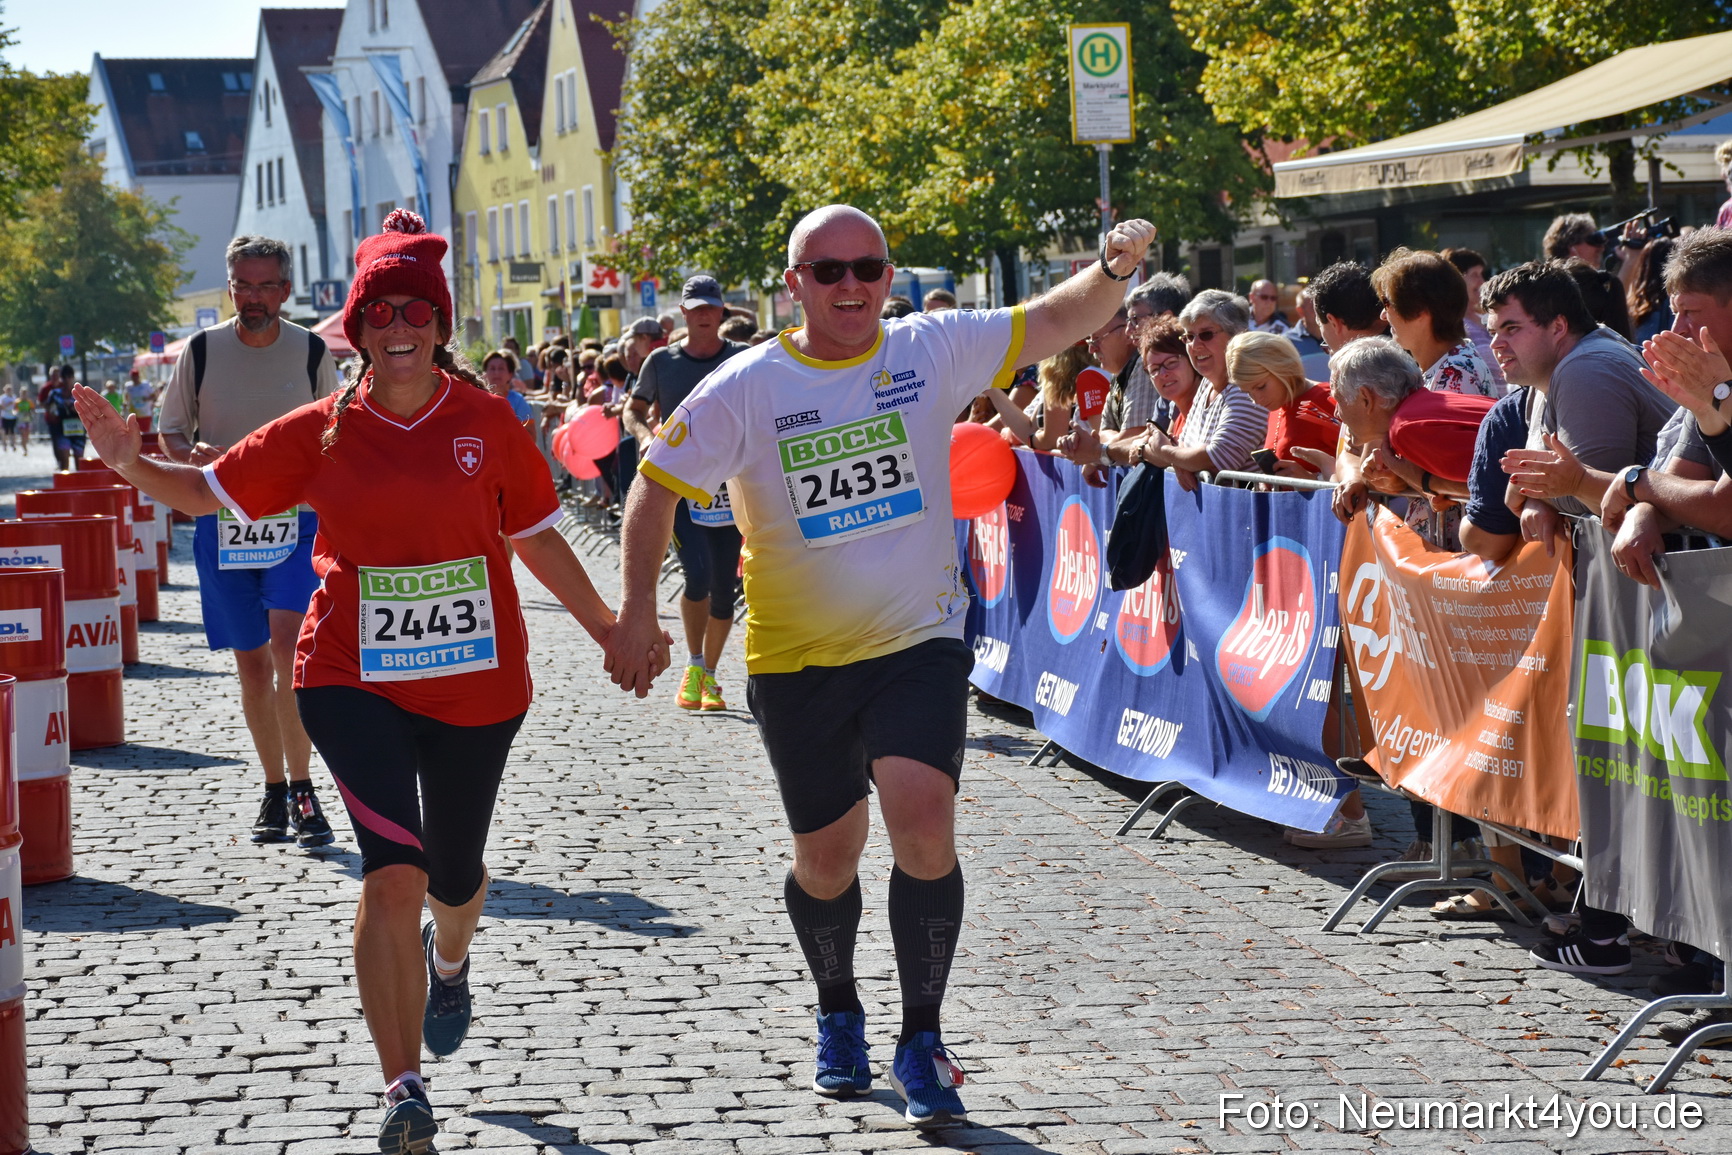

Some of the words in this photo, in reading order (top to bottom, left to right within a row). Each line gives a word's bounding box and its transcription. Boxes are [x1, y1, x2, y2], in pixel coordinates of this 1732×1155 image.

[1083, 82, 1120, 90] Marktplatz
[894, 371, 915, 383] JAHRE
[874, 379, 926, 400] Neumarkter
[876, 392, 919, 411] Stadtlauf
[775, 410, 820, 428] BOCK
[788, 418, 897, 467] BOCK
[800, 454, 902, 510] 2433
[828, 501, 893, 531] RALPH
[228, 522, 290, 545] 2447
[228, 548, 289, 562] REINHARD
[369, 563, 476, 597] BOCK
[1055, 528, 1097, 612] Hervis
[1432, 571, 1470, 593] Neumarkts
[1511, 573, 1553, 591] Partner
[479, 599, 486, 607] D
[1499, 599, 1521, 617] und
[374, 599, 477, 642] 2443
[1225, 582, 1311, 680] Hervis
[1467, 625, 1508, 647] Projekte
[1508, 627, 1527, 641] was
[380, 644, 476, 668] BRIGITTE
[1227, 662, 1258, 687] SPORTS
[1382, 714, 1452, 764] Agentur
[1502, 758, 1524, 779] 897
[919, 917, 955, 996] kalenji
